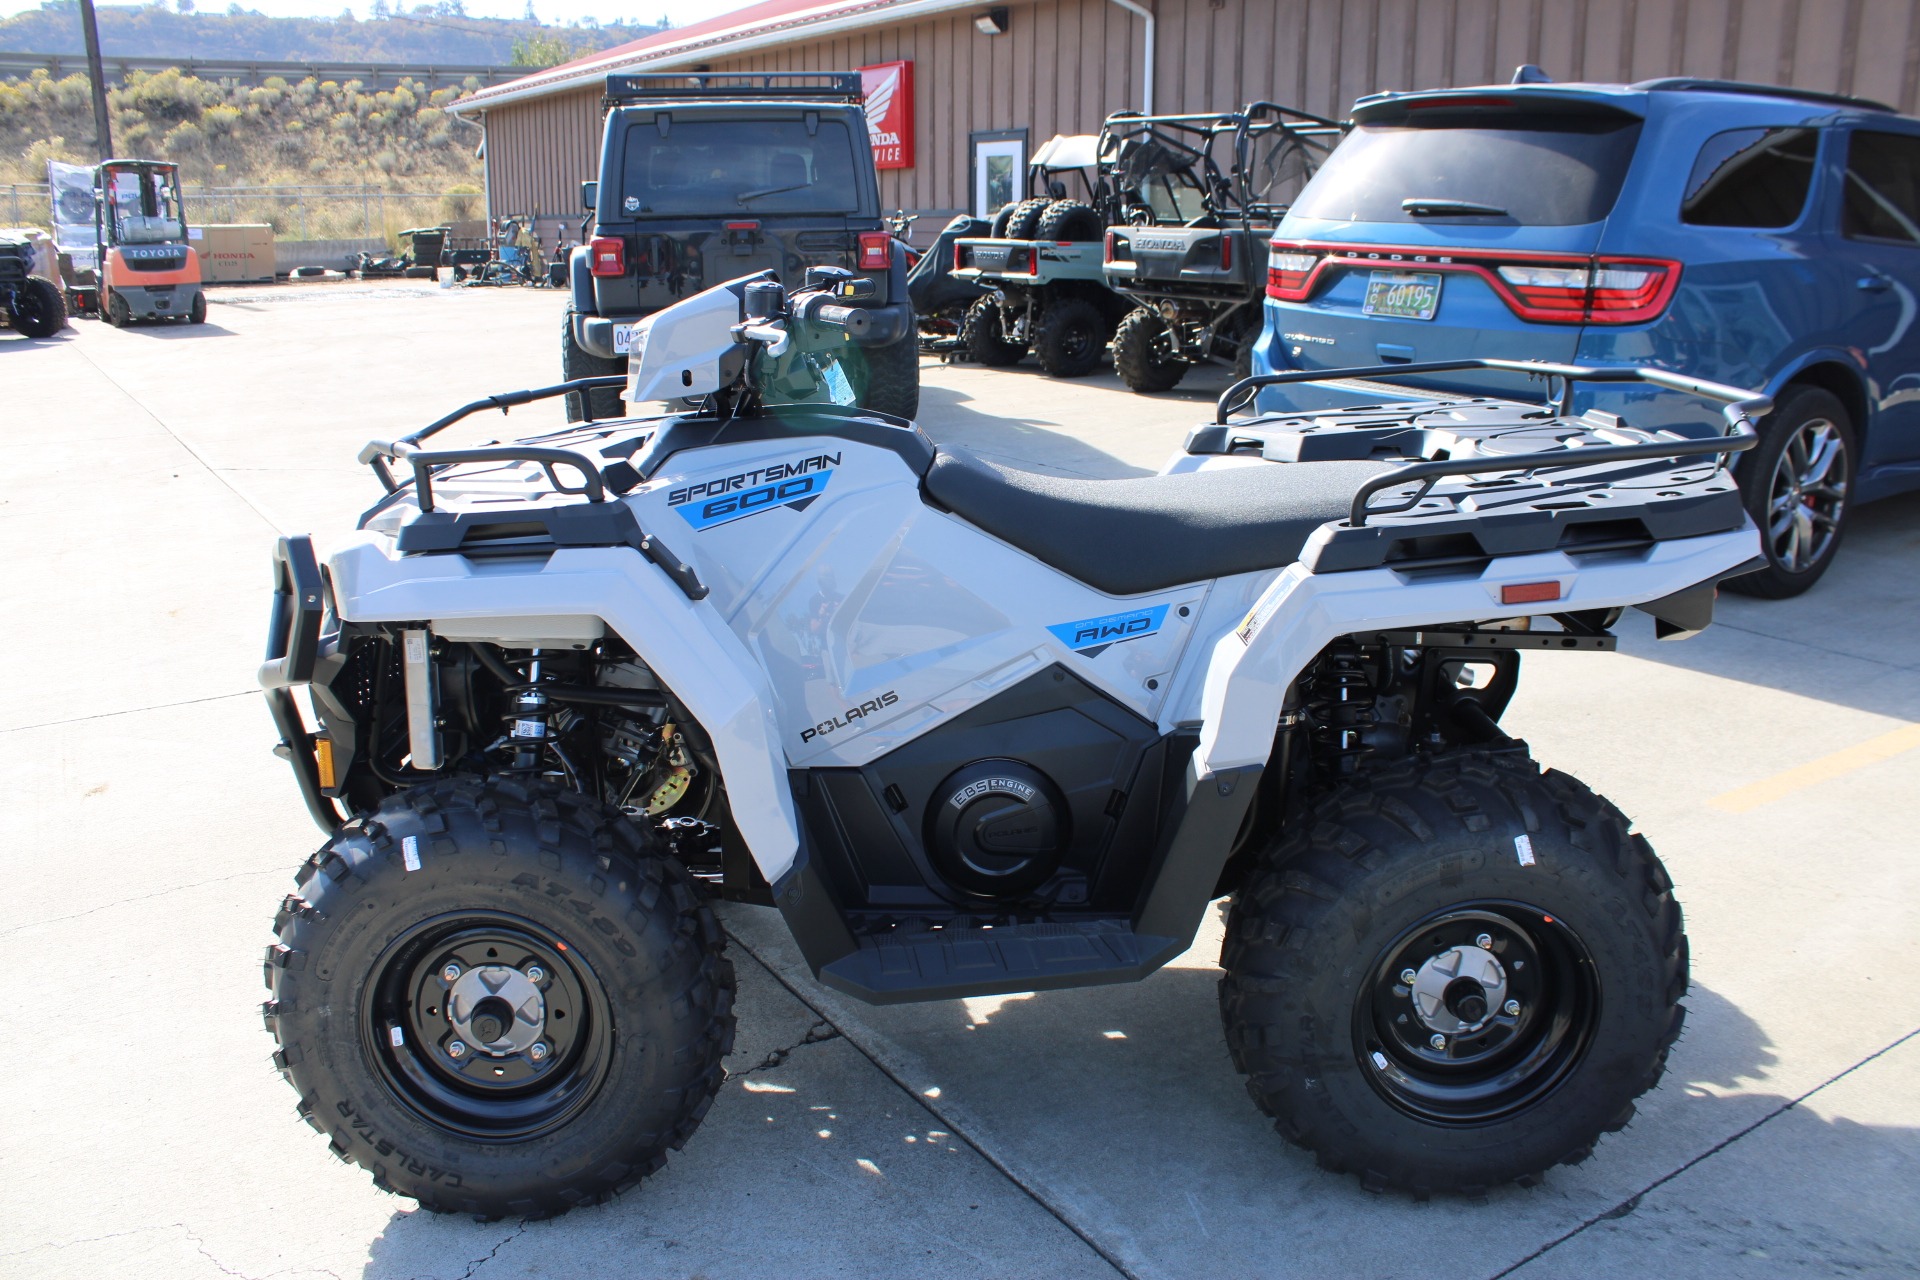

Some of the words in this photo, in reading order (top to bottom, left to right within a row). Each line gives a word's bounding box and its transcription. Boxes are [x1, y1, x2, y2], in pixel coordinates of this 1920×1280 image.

[870, 132, 901, 146] NDA
[874, 147, 901, 162] VICE
[132, 249, 181, 258] TOYOTA
[975, 250, 1007, 260] HONDA
[1135, 238, 1187, 251] HONDA
[1347, 251, 1452, 264] DODGE
[1387, 284, 1434, 309] 60195
[667, 451, 842, 507] SPORTSMAN
[702, 477, 814, 520] 600
[1075, 621, 1094, 629] ON
[1098, 609, 1154, 625] DEMAND
[1074, 618, 1151, 644] AWD
[800, 690, 899, 744] POLARIS
[954, 781, 987, 806] EBS
[990, 779, 1033, 796] ENGINE
[336, 1100, 463, 1188] CARLSTAR
